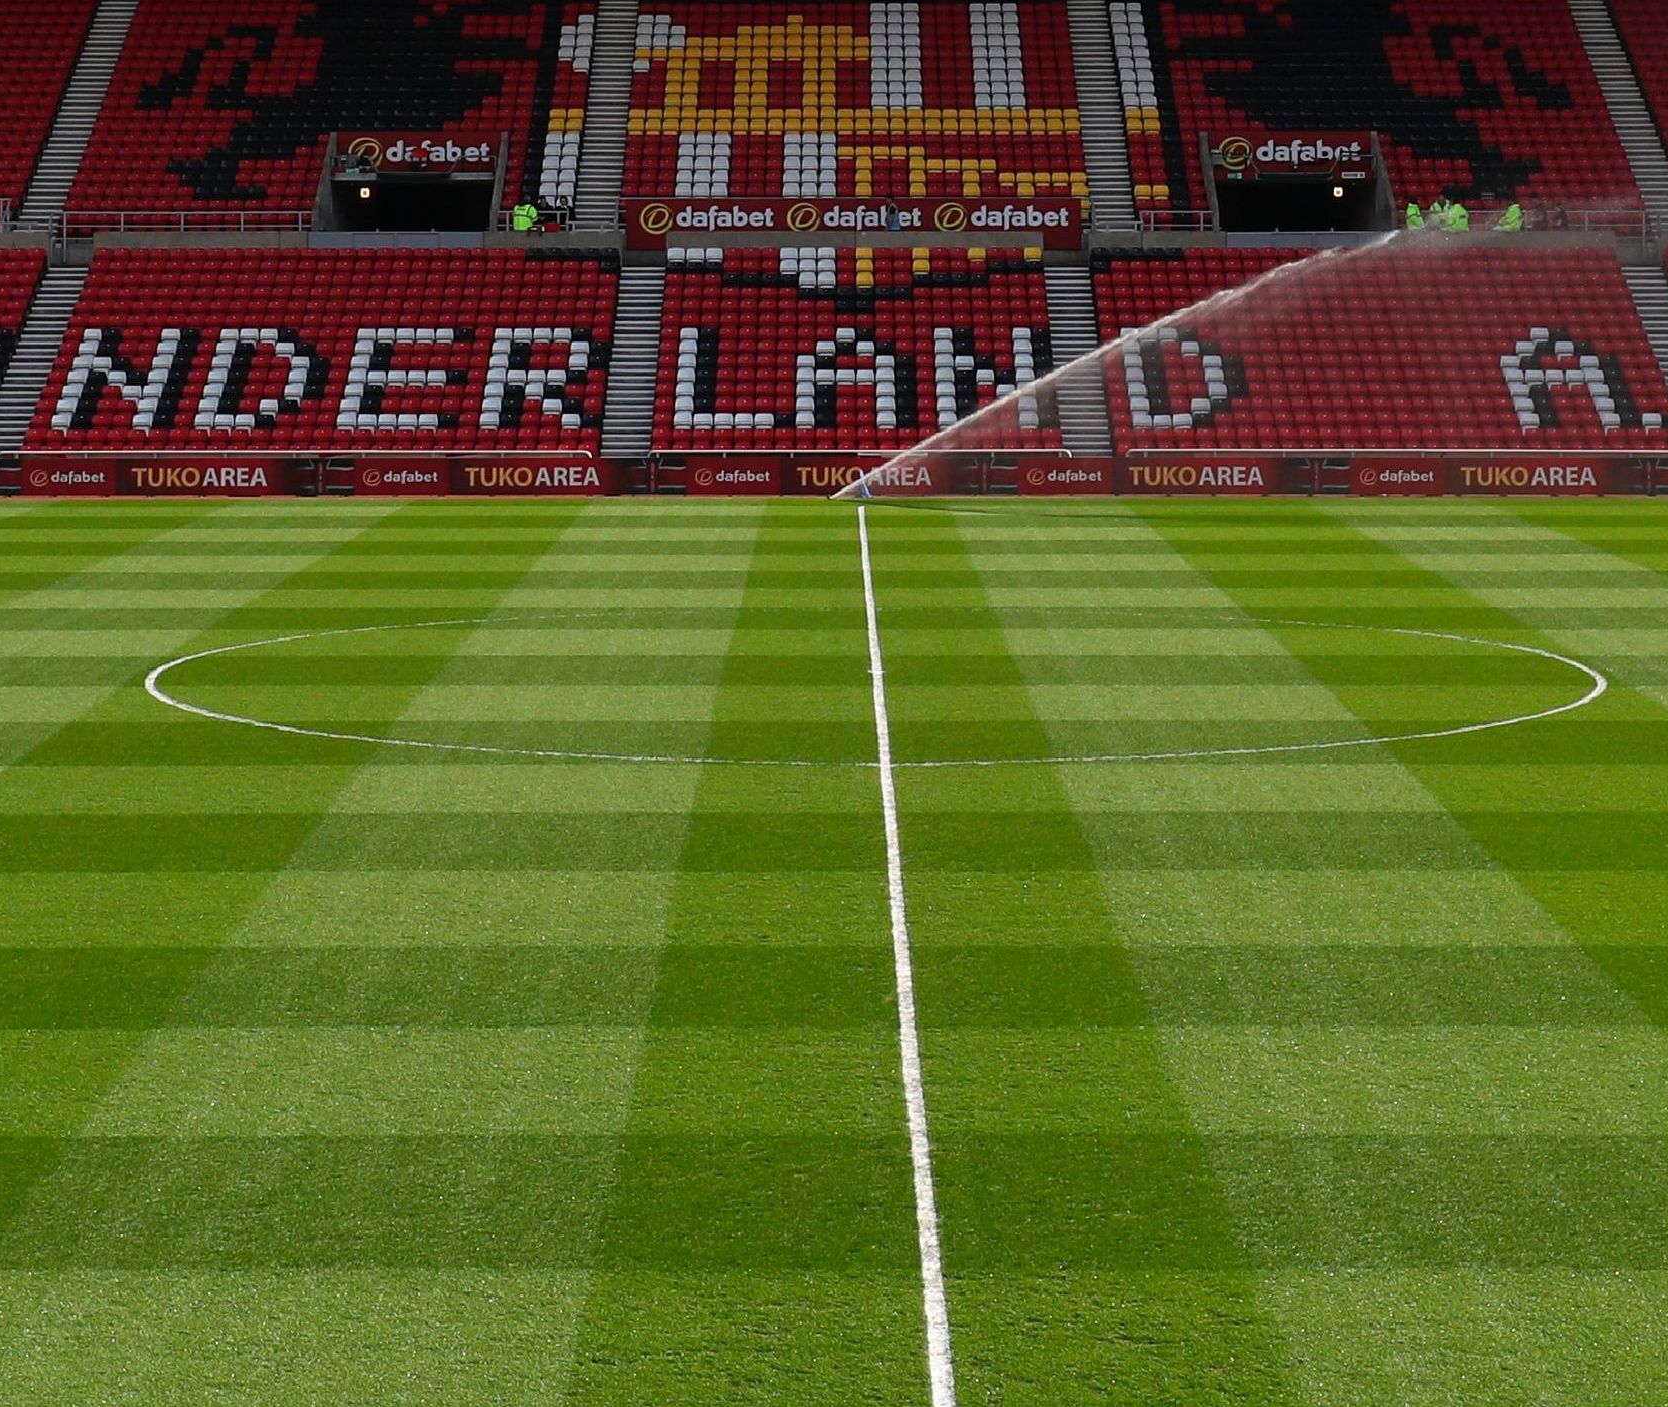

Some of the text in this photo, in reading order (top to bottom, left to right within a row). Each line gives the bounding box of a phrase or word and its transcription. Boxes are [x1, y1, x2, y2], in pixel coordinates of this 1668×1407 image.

[676, 205, 774, 231] dafabet
[971, 205, 1069, 231] dafabet
[50, 470, 105, 486] dafabet
[383, 470, 438, 486] dafabet
[715, 469, 770, 485] dafabet
[1047, 469, 1102, 485] dafabet
[1379, 469, 1434, 485] dafabet
